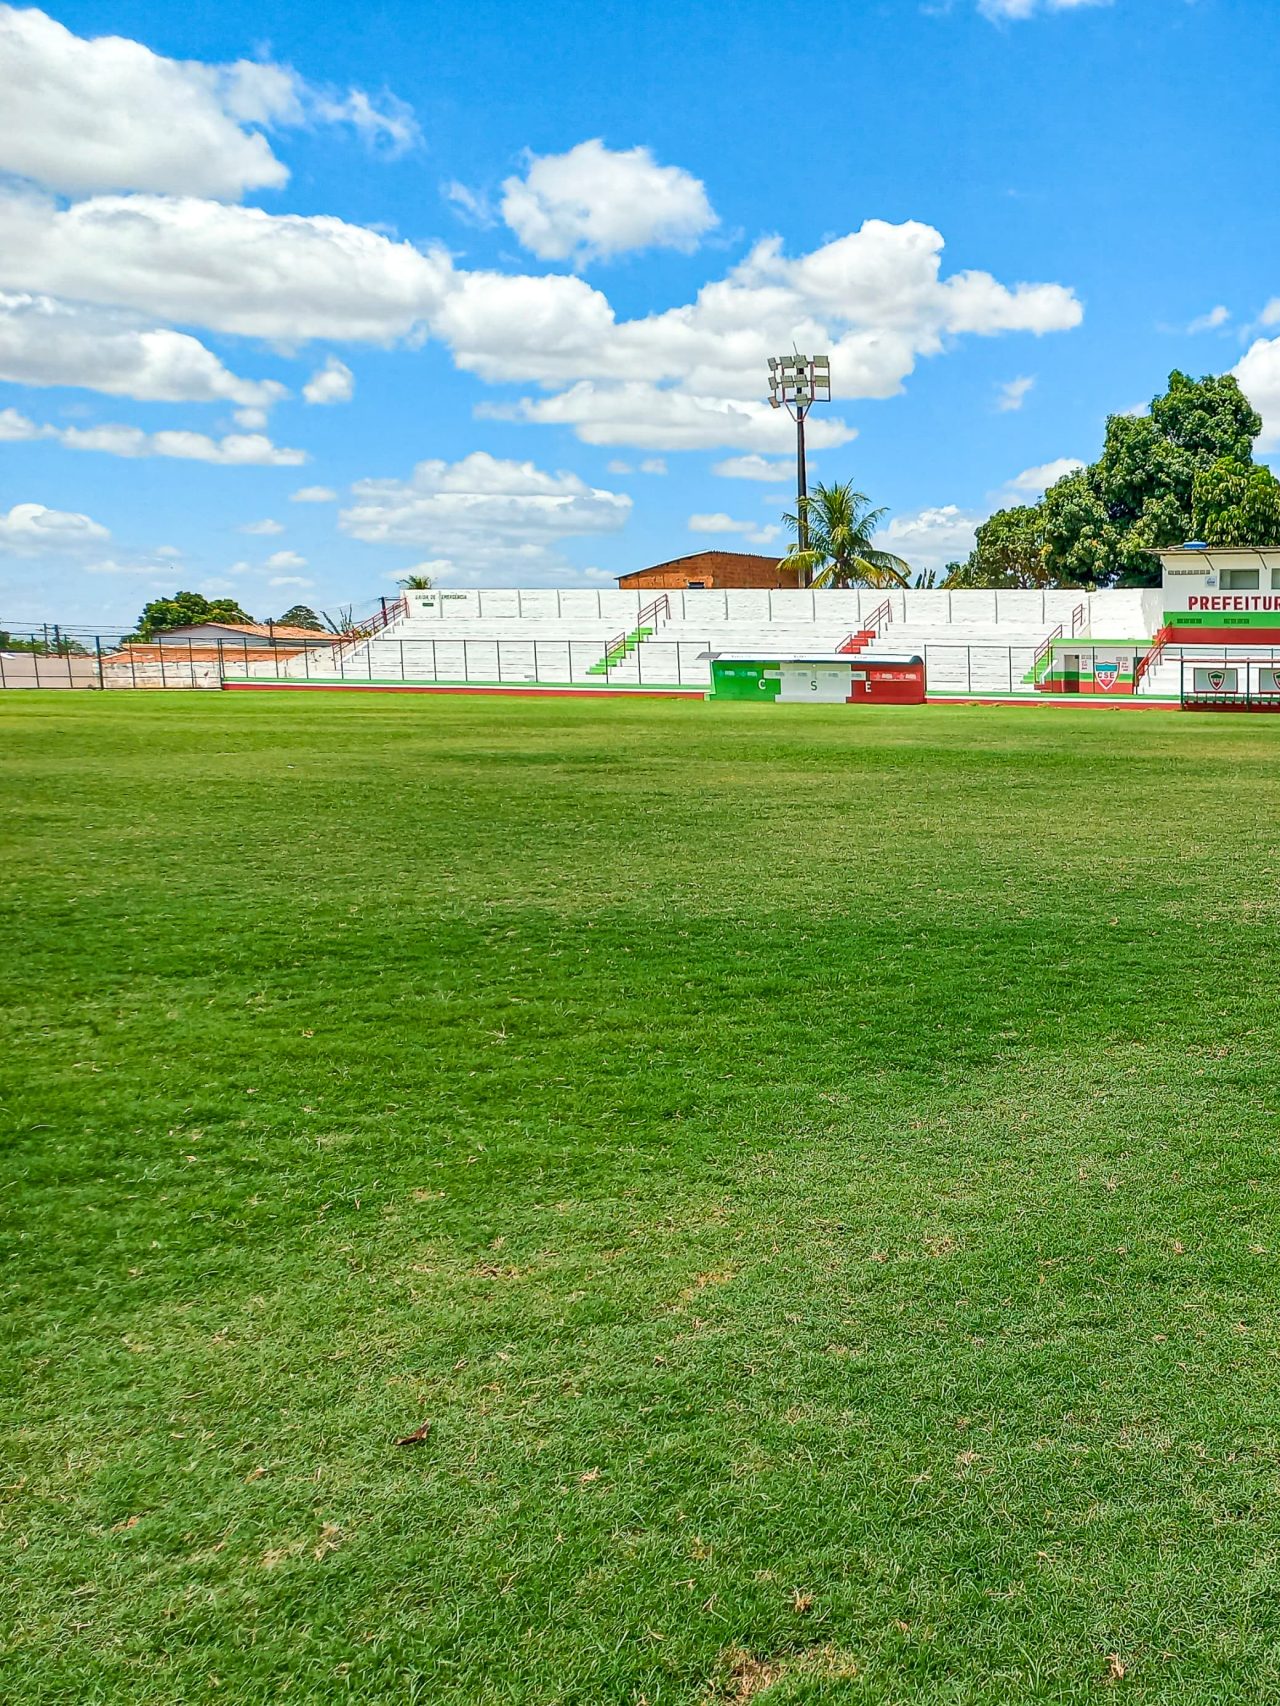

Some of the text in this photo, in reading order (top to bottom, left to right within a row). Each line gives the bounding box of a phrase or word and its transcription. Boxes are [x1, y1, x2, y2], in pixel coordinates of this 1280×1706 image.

[1097, 671, 1115, 679] CSE
[758, 679, 872, 692] C S E
